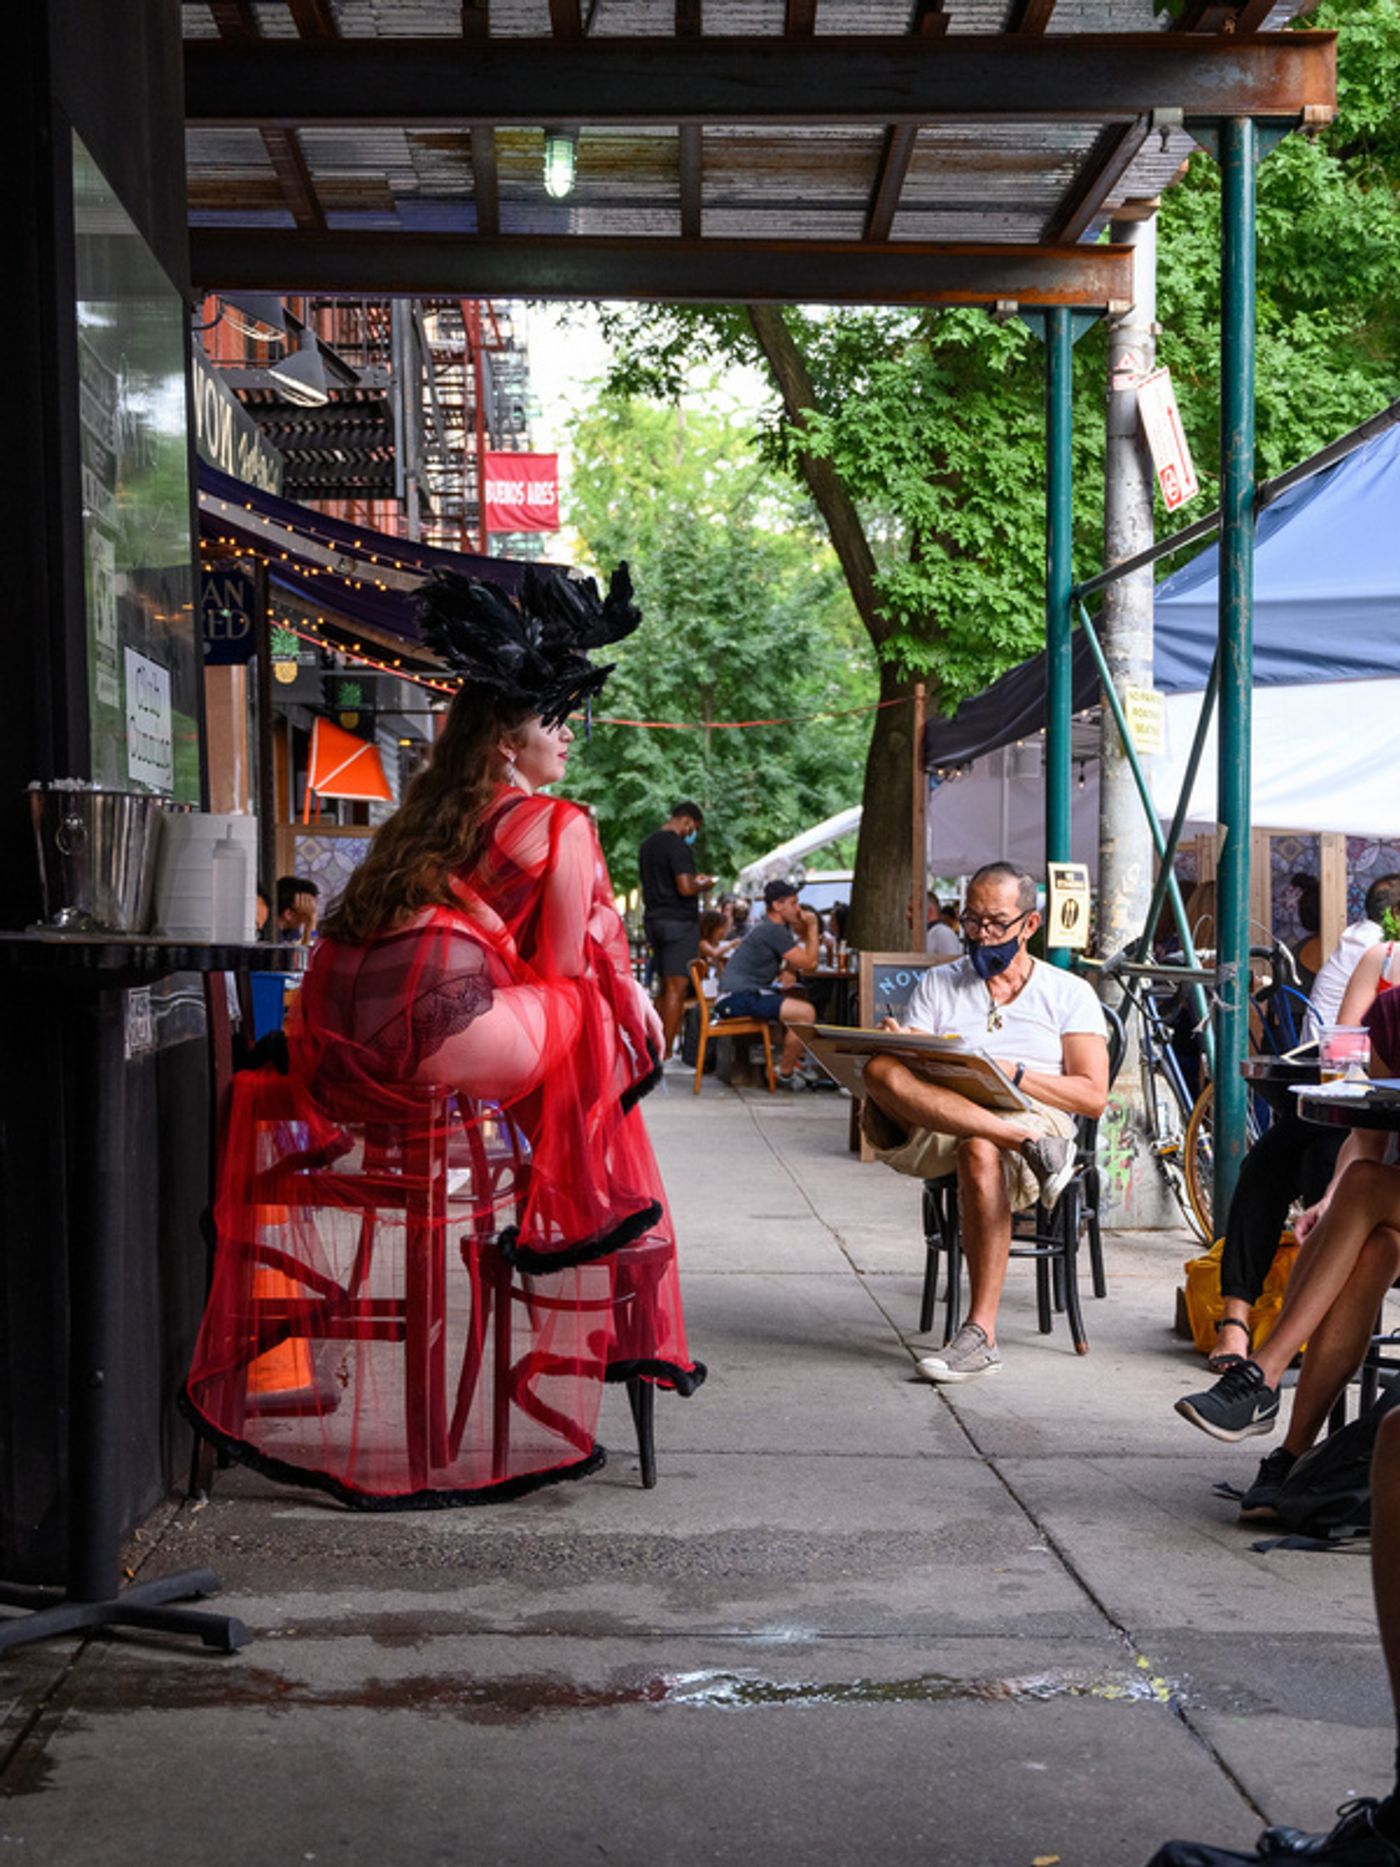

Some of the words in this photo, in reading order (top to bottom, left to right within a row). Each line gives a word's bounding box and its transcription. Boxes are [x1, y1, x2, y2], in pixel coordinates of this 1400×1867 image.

[485, 479, 525, 506] BUENOS
[527, 480, 555, 506] AIRES
[202, 609, 251, 640] ED
